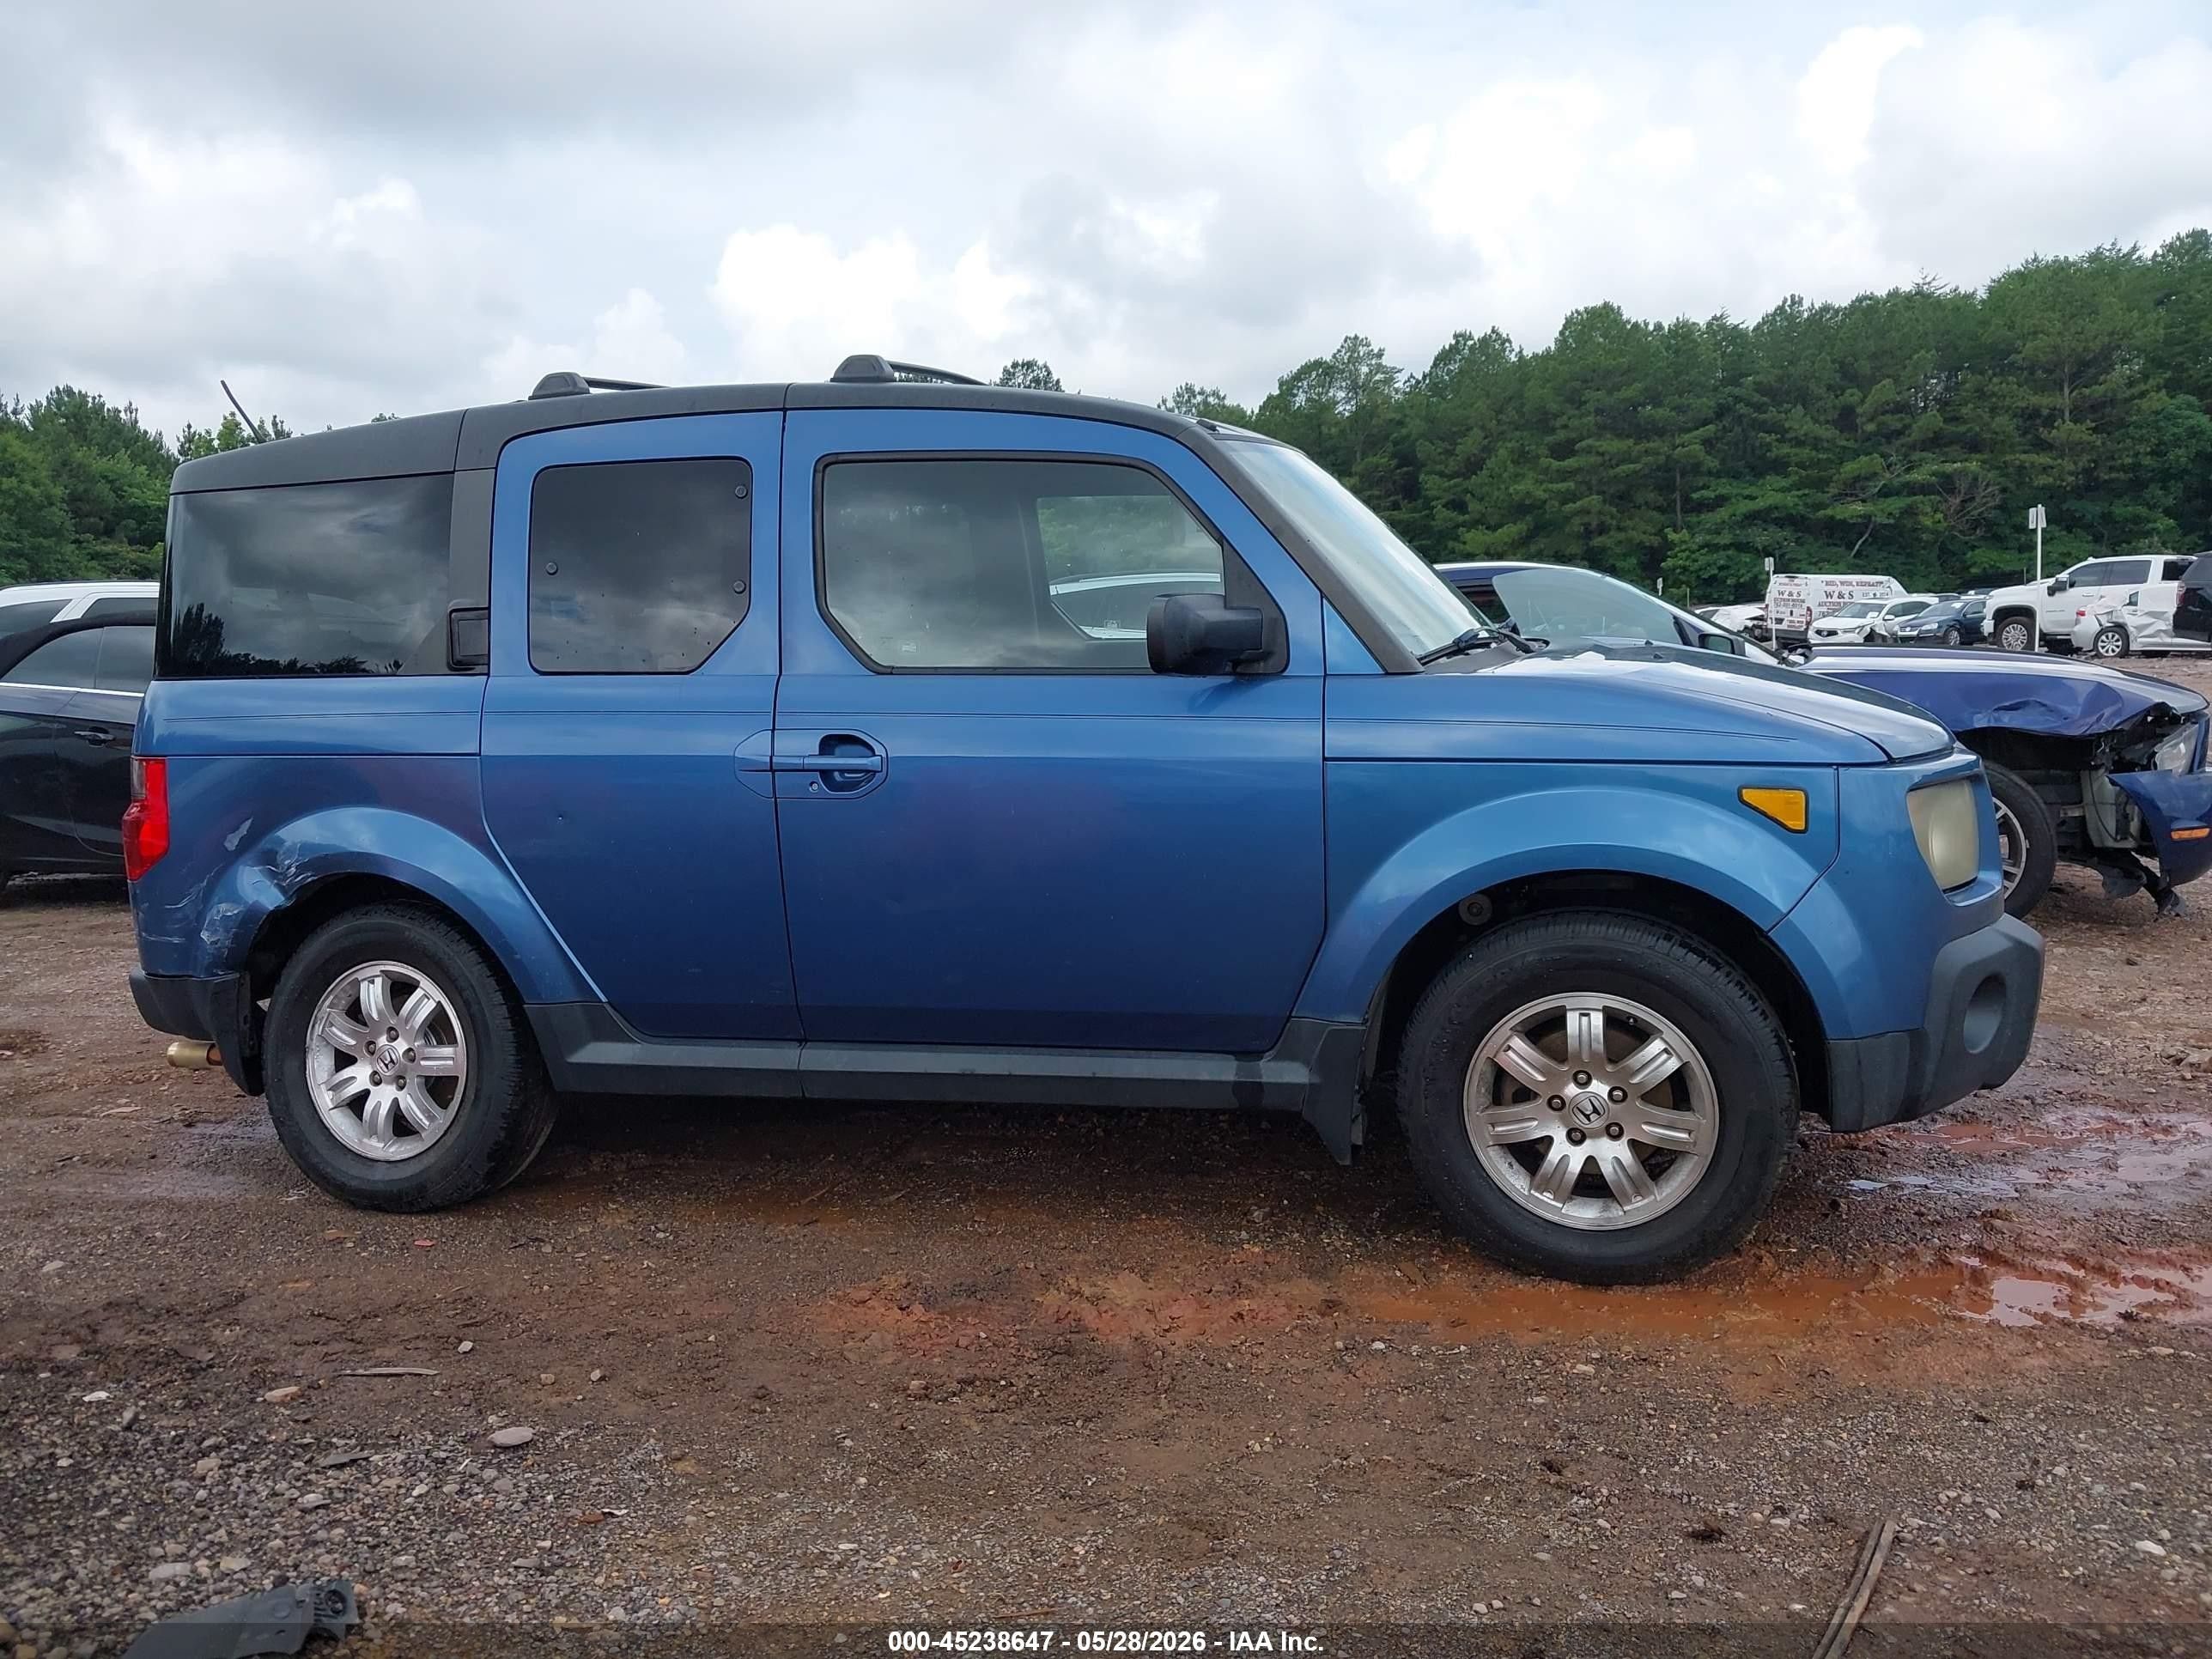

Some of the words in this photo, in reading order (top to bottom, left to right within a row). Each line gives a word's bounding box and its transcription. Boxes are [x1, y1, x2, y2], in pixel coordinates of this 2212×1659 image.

[1824, 591, 1835, 599] W
[1838, 591, 1845, 599] &
[1848, 591, 1854, 599] S
